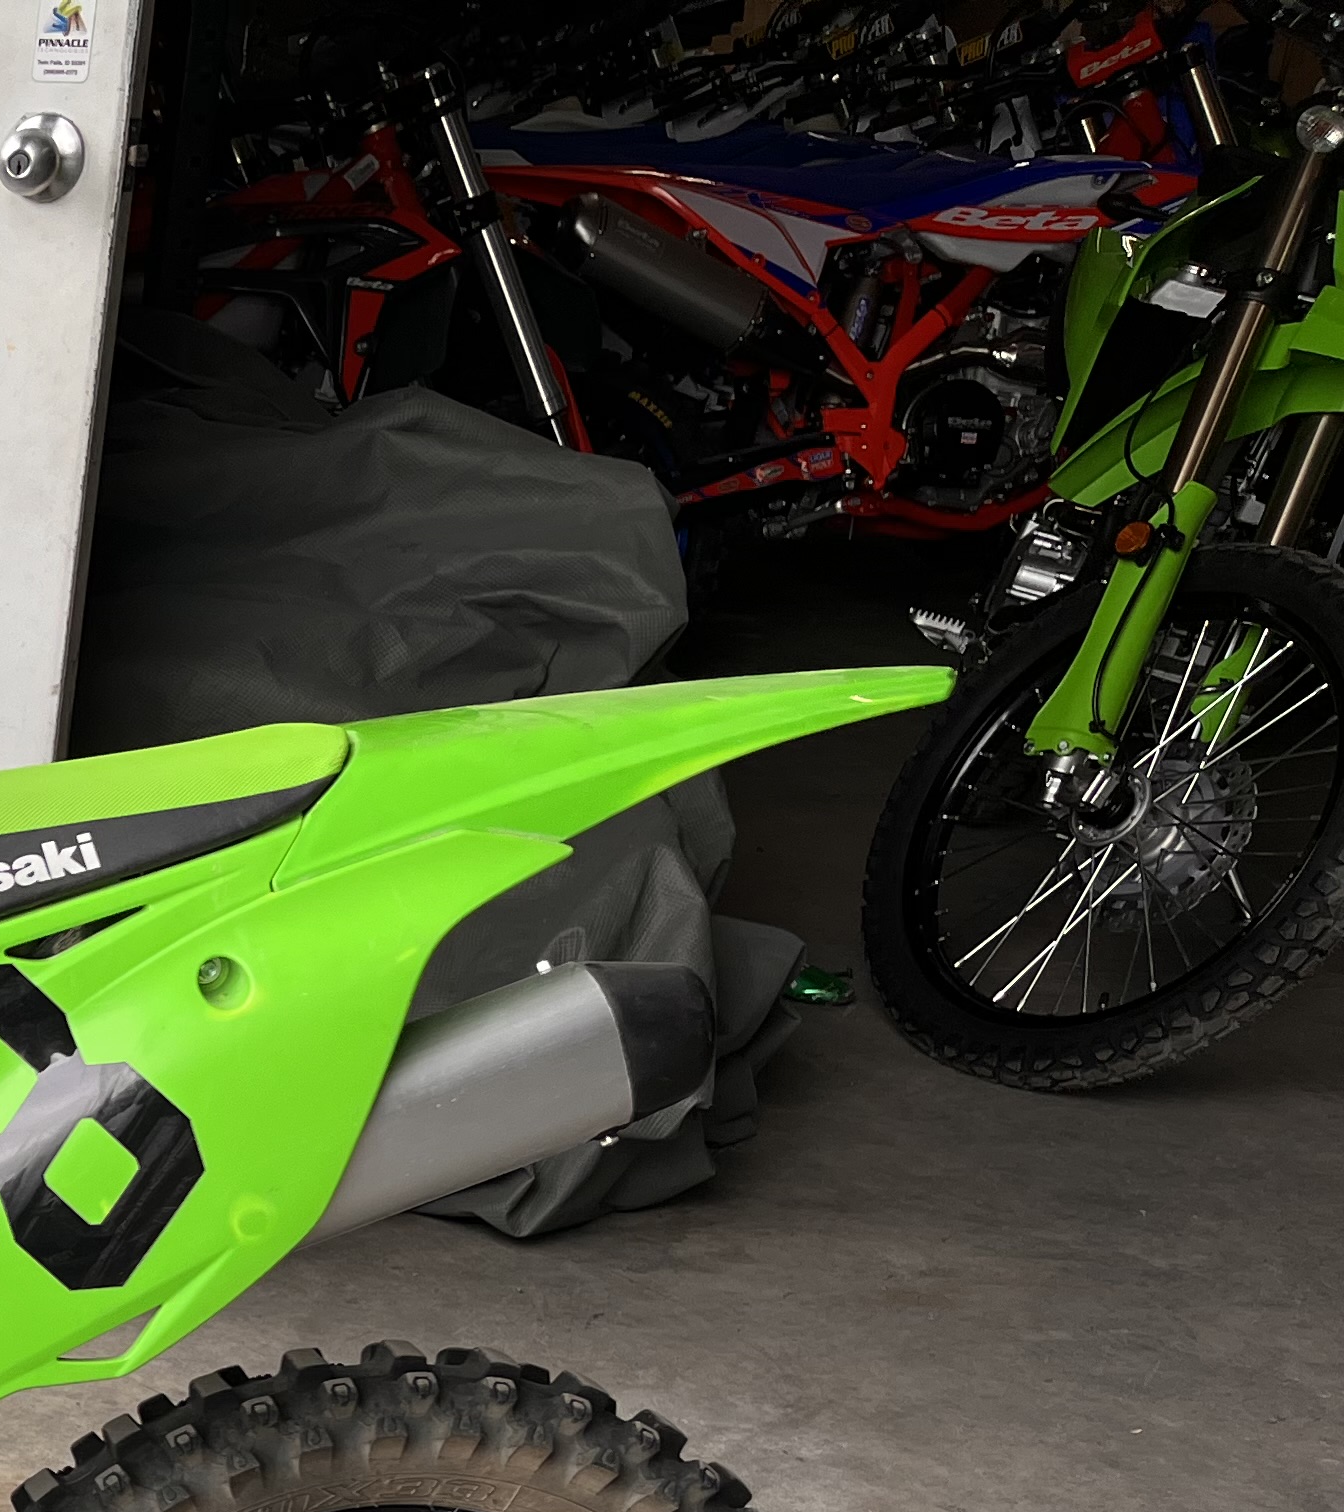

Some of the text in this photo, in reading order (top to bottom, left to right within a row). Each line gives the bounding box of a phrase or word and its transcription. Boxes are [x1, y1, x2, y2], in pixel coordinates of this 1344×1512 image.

[38, 38, 89, 48] PINNACLE
[1080, 38, 1152, 80] Beta
[932, 206, 1100, 231] Beta
